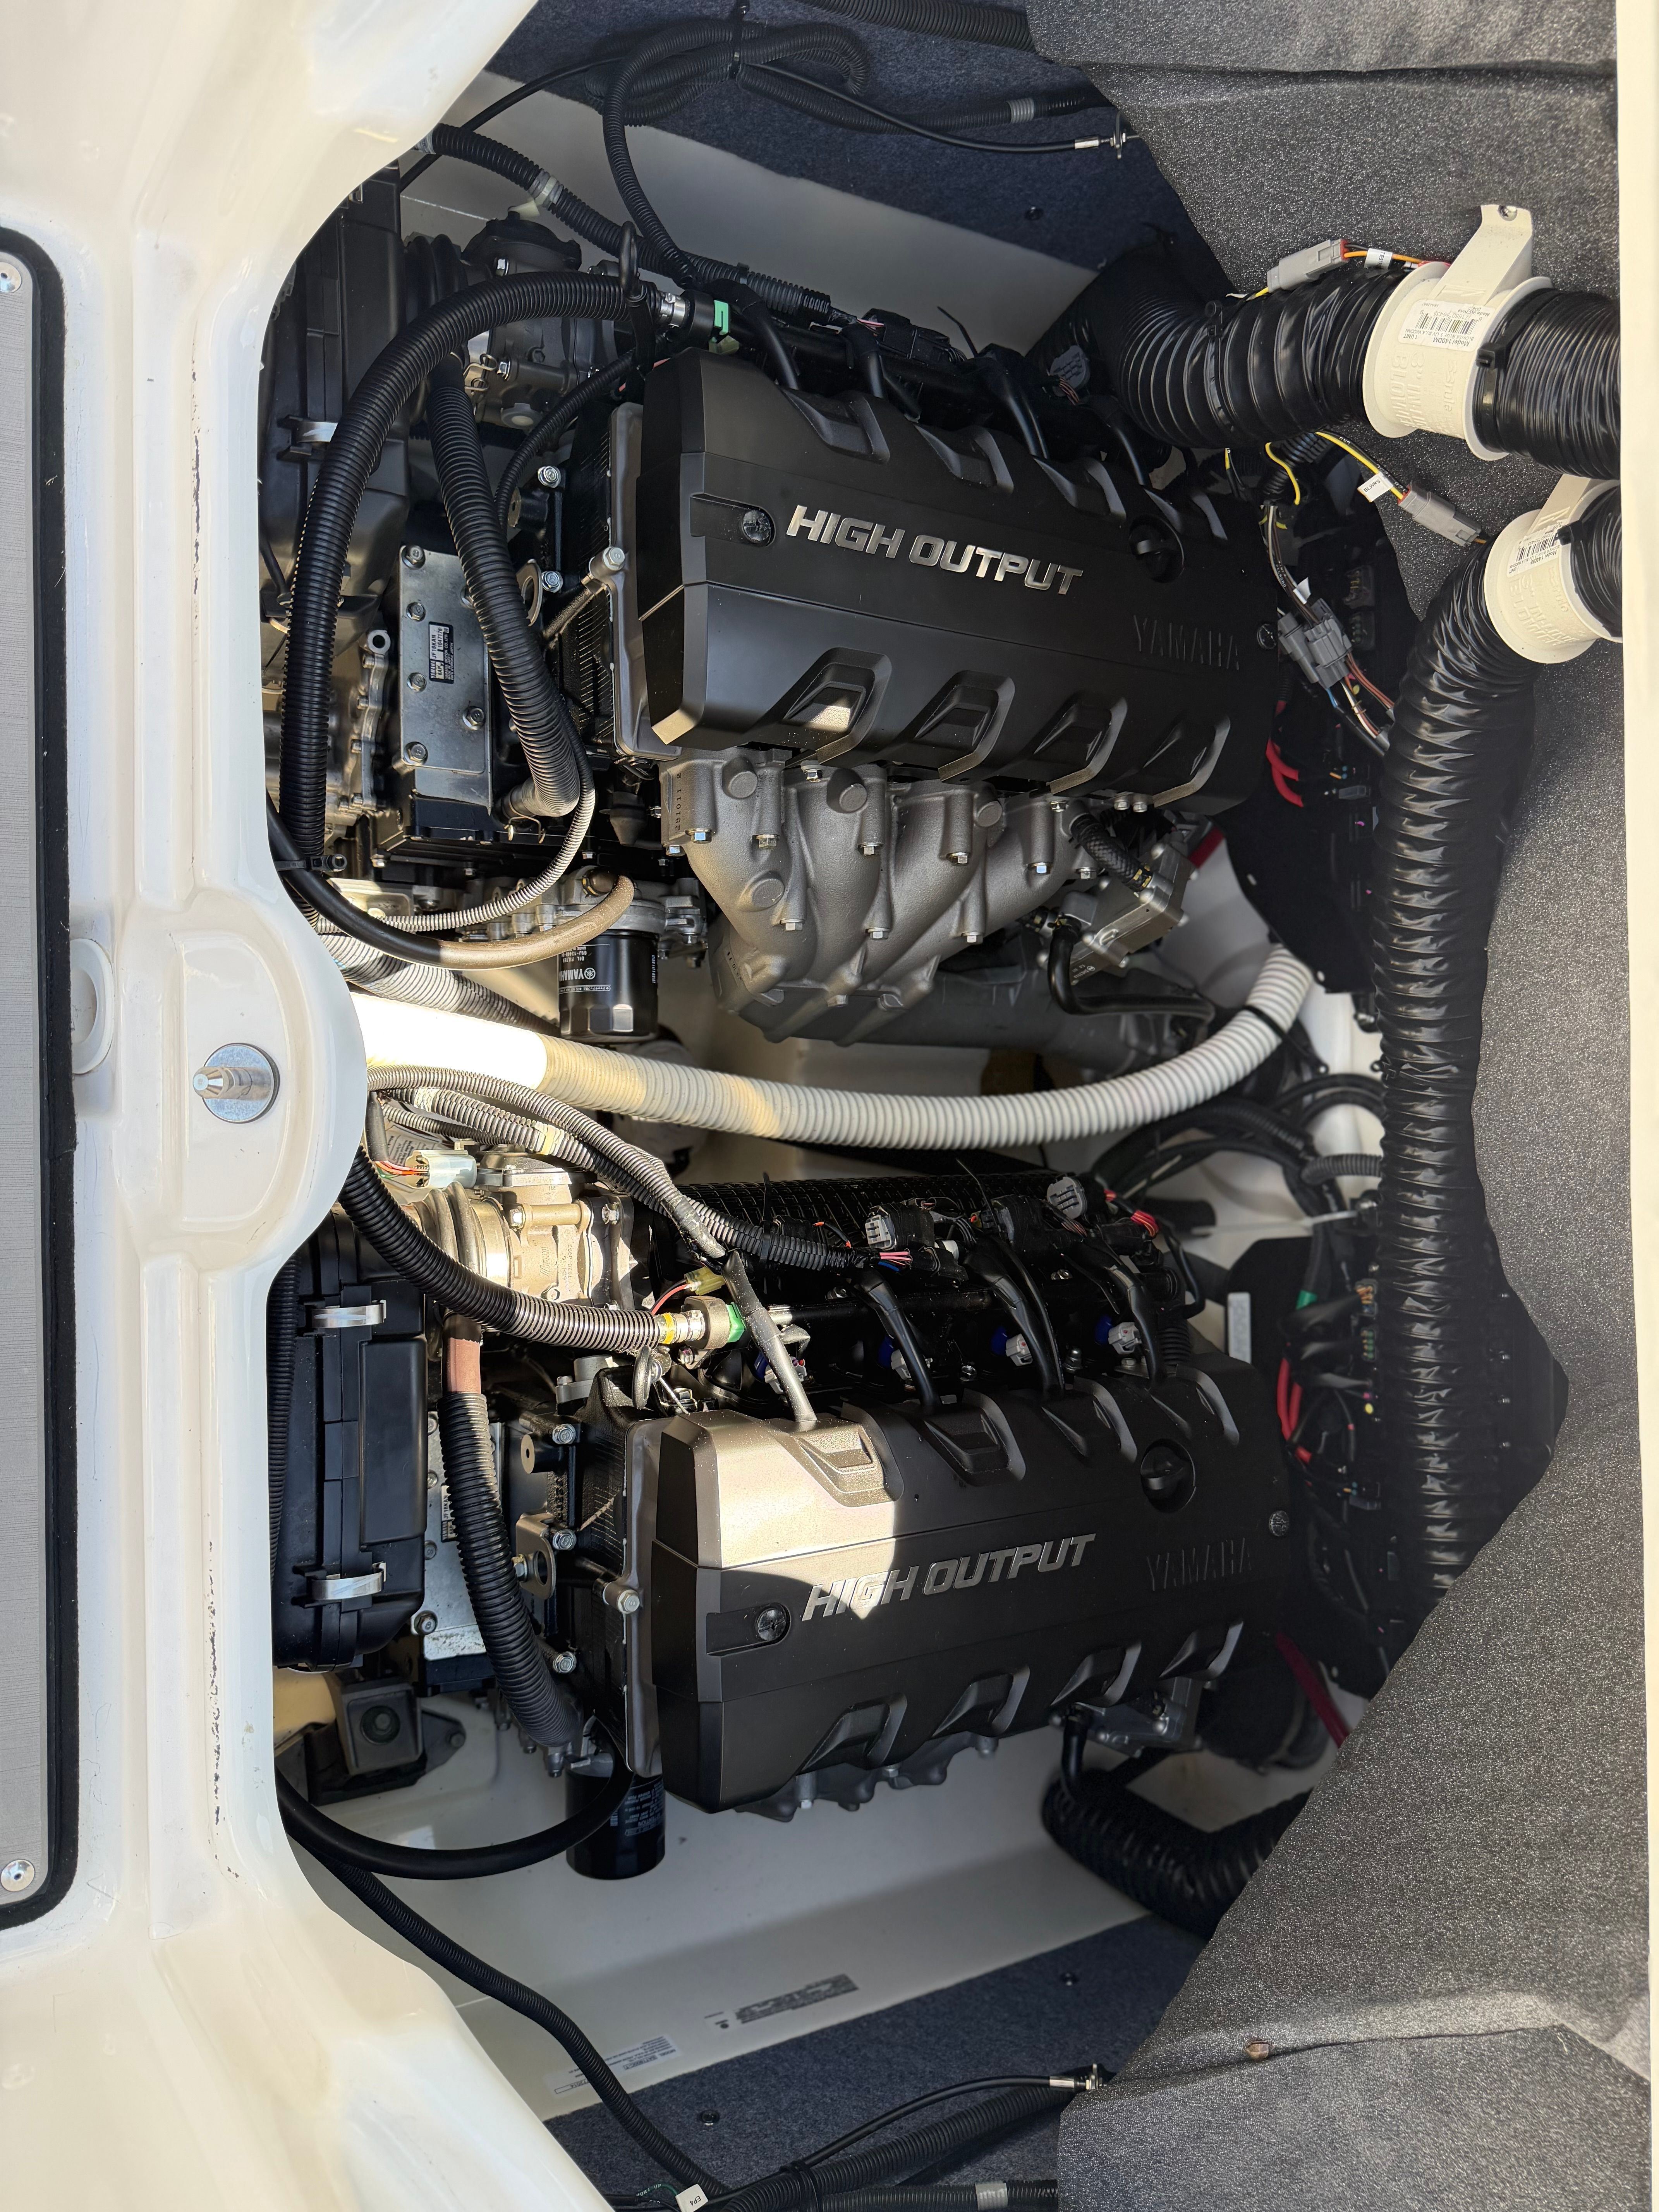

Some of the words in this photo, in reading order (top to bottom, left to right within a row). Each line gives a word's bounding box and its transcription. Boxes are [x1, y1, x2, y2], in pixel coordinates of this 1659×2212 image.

[1363, 479, 1381, 492] BLWRS
[787, 505, 905, 558] HIGH
[909, 534, 1084, 595] OUTPUT
[1133, 615, 1240, 670] YAMAHA
[558, 969, 584, 981] YAMAHA
[801, 1565, 919, 1621] HIGH
[922, 1533, 1096, 1595] OUTPUT
[1146, 1537, 1252, 1591] YAMAHA
[690, 2195, 702, 2206] EP4
